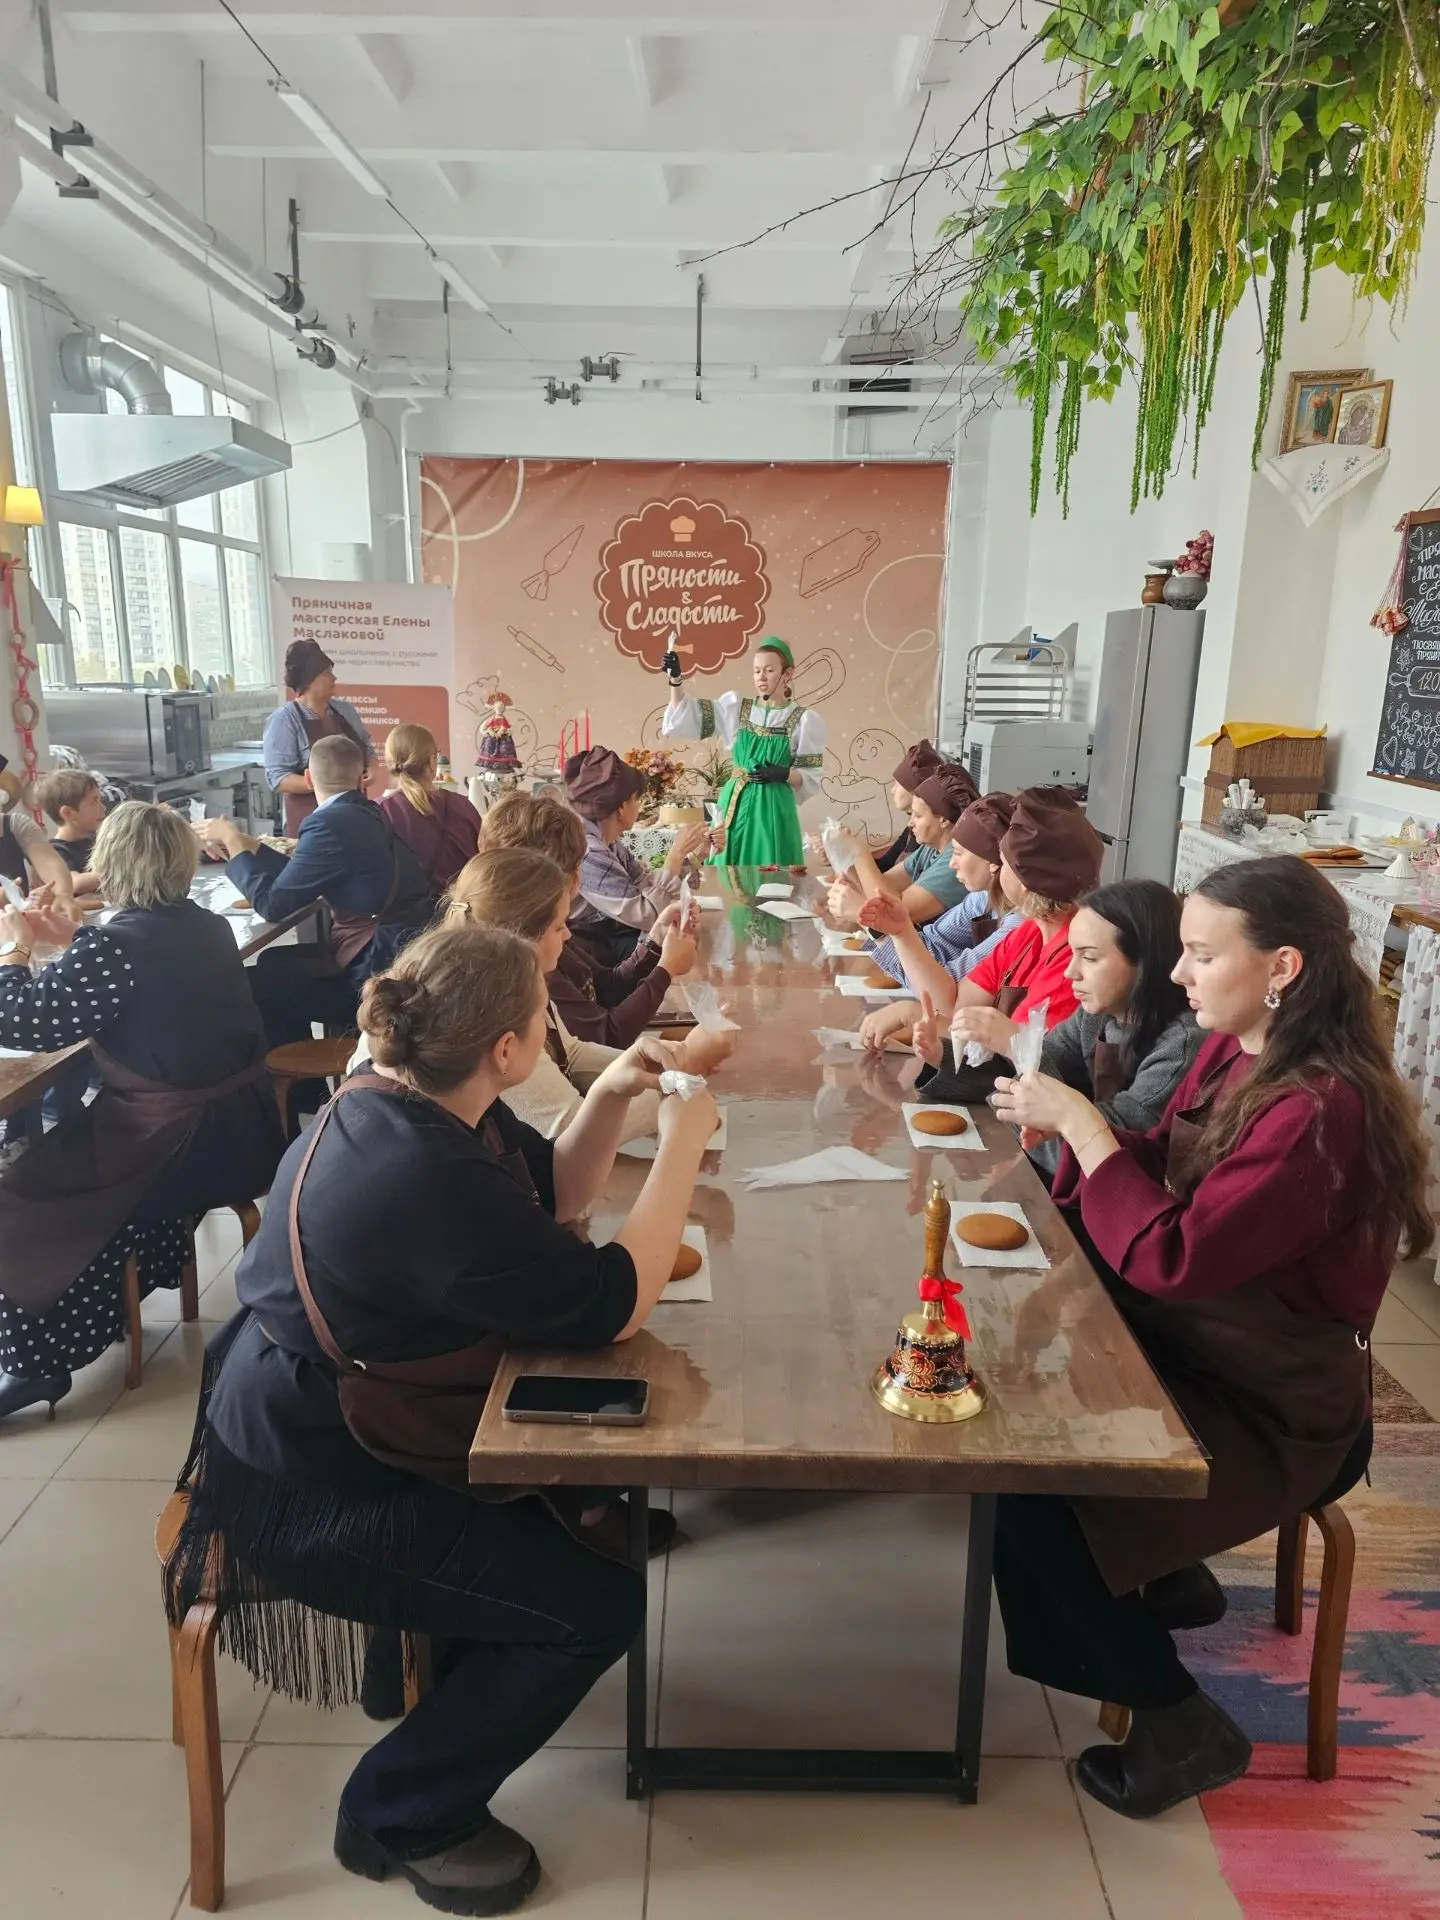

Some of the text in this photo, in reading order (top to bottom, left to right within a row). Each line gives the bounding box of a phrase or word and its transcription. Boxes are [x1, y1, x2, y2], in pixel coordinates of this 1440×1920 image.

[652, 550, 713, 559] ШКОЛА ВКУСА
[619, 558, 747, 599] Пряности
[292, 596, 373, 611] Пряничная
[292, 613, 431, 628] мастерская Елены
[626, 595, 745, 637] Сладости
[294, 627, 386, 641] Маслаковой
